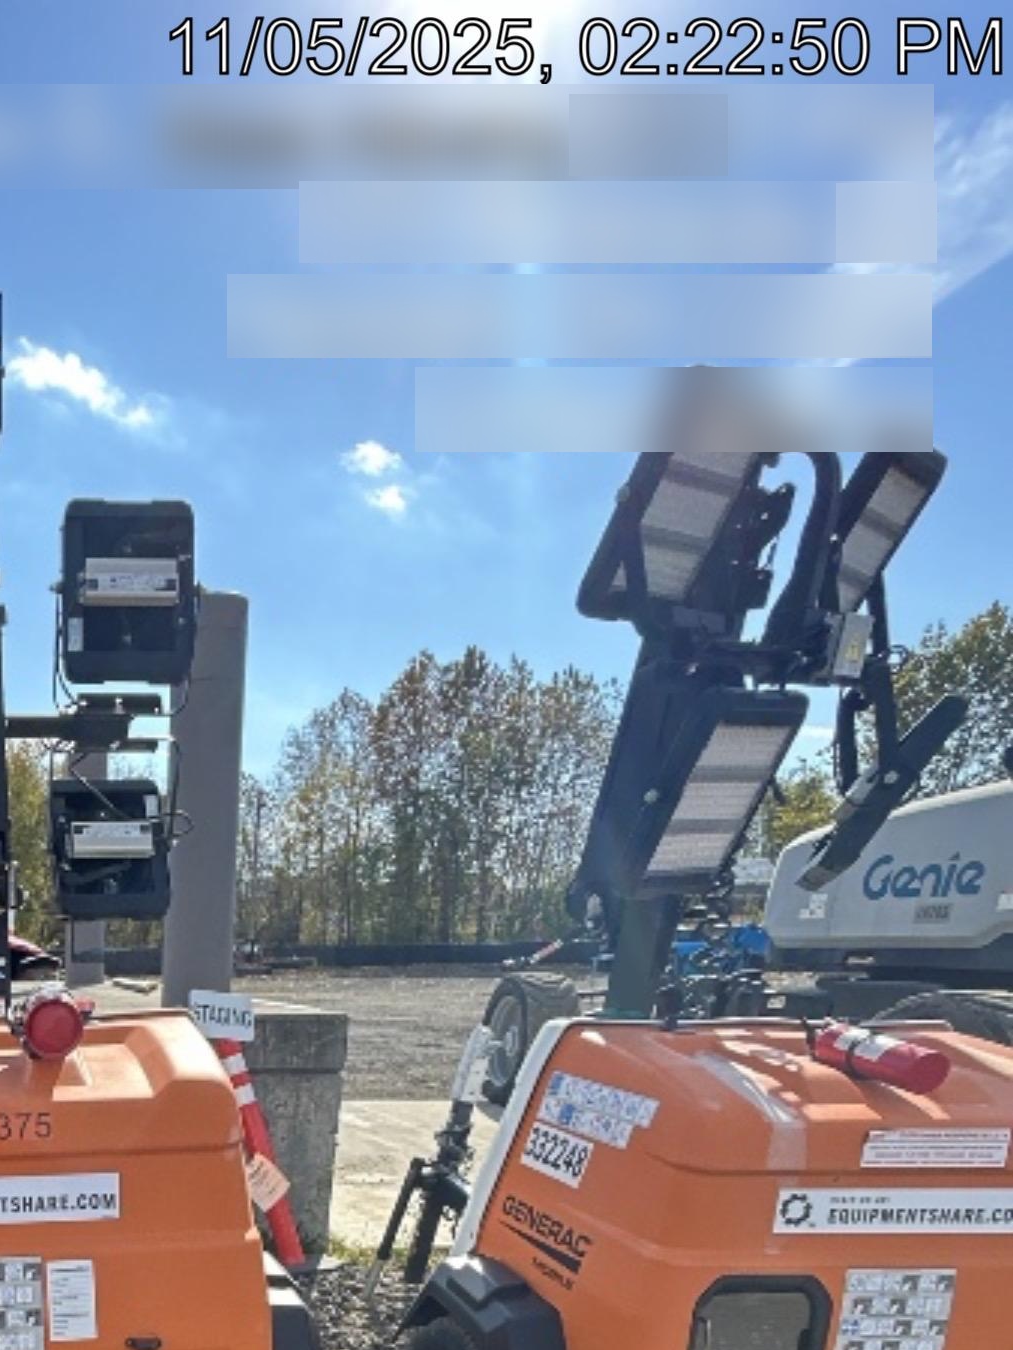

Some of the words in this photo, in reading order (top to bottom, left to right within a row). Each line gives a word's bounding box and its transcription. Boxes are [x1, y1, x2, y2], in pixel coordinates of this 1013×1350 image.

[863, 852, 985, 900] Genie
[524, 1126, 588, 1177] 332248
[502, 1196, 592, 1258] GENERAC
[827, 1207, 1013, 1225] EQUIPMENTSHARE.CO
